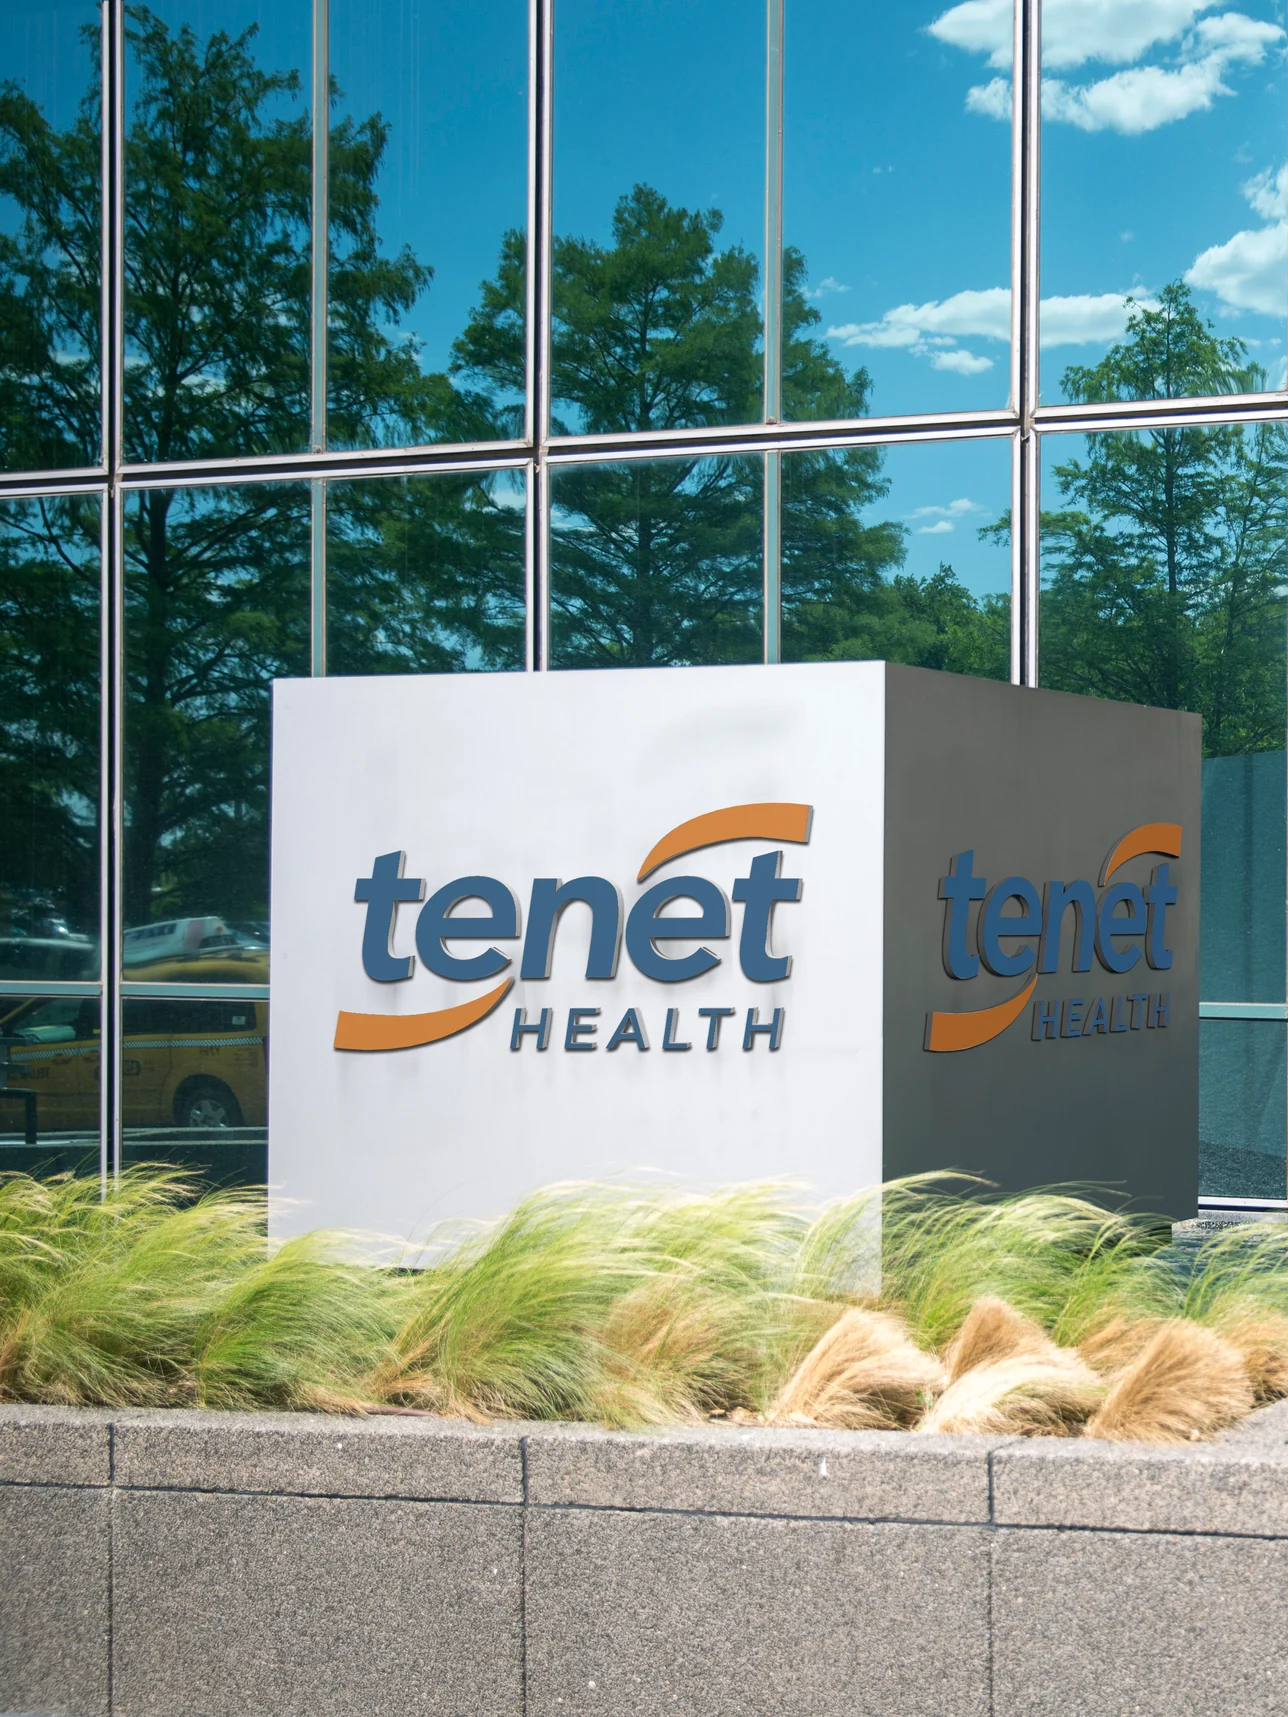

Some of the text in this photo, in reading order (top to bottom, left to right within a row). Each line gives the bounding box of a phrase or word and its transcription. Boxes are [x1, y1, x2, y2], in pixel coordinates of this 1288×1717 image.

[354, 849, 803, 981] tenet
[937, 849, 1178, 980] tenet
[509, 1006, 785, 1051] HEALTH
[1031, 993, 1170, 1041] HEALTH
